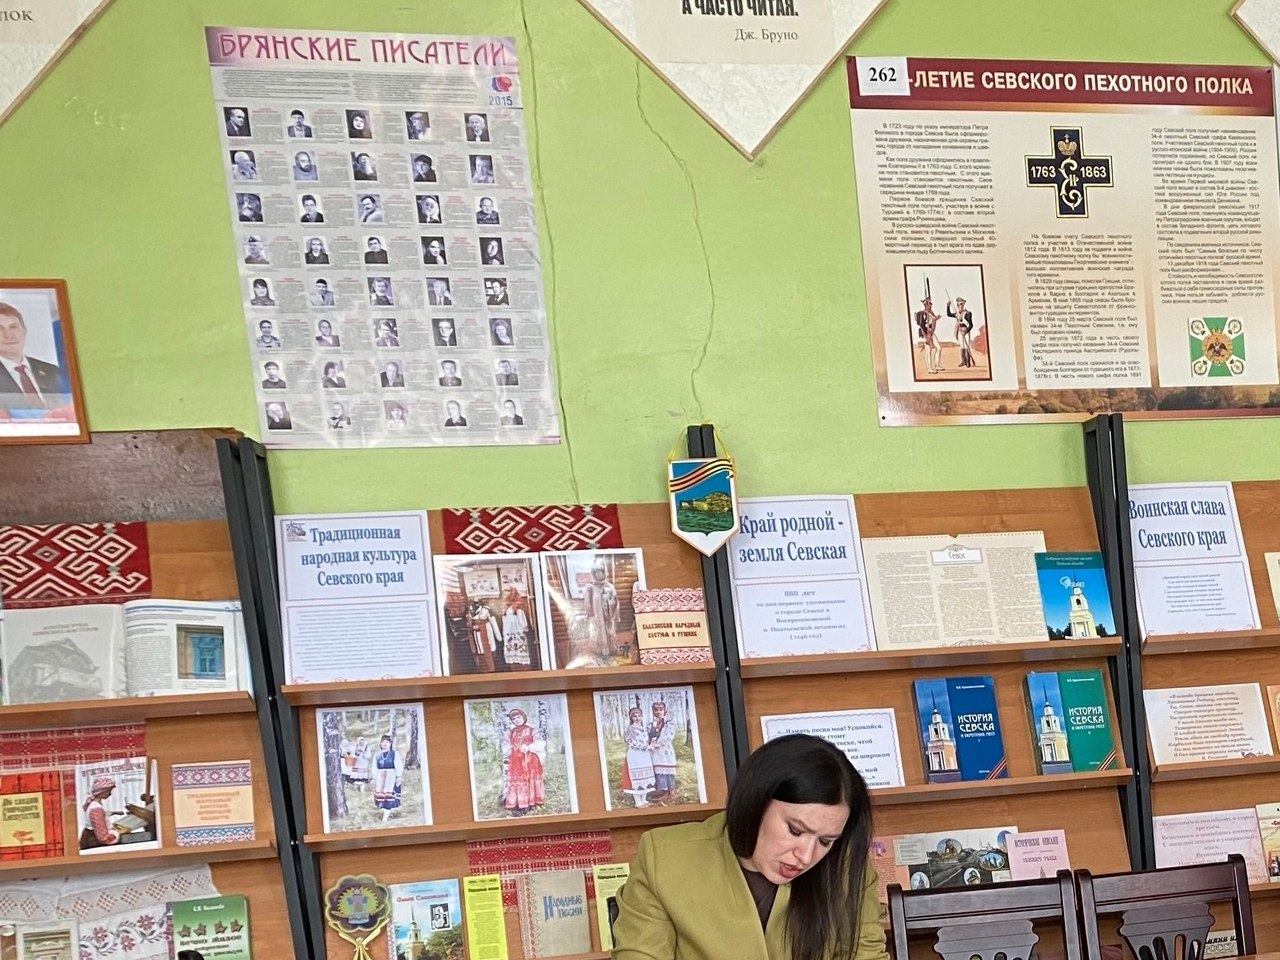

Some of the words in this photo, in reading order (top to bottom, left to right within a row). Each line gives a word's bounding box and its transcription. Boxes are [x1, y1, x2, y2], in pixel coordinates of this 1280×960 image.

[682, 0, 692, 15] А
[697, 0, 744, 16] ЧАСТО
[749, 0, 799, 17] ЧИТАЯ.
[734, 28, 757, 42] Дж.
[761, 28, 799, 43] Бруно
[219, 33, 362, 62] БРЯНСКИЕ
[370, 38, 510, 67] ПИСАТЕЛИ
[868, 66, 898, 84] 262
[981, 71, 1078, 92] СЕВСКОГО
[1084, 73, 1188, 94] ПЕХОТНОГО
[1194, 75, 1254, 96] ПОЛКА
[488, 95, 514, 107] 2015
[1030, 165, 1057, 178] 1763
[1080, 165, 1107, 178] 1863
[1128, 497, 1189, 520] Воинская
[1191, 500, 1226, 516] слава
[739, 511, 777, 538] Край
[779, 510, 834, 536] родной
[310, 525, 401, 545] Традиционная
[1138, 527, 1195, 548] Севского
[1197, 529, 1227, 550] края
[301, 550, 359, 568] народная
[362, 548, 417, 566] культура
[739, 547, 785, 563] земля
[787, 540, 847, 560] Севская
[317, 569, 373, 587] Севского
[376, 569, 404, 587] края
[957, 713, 993, 723] ИСТОРИЯ
[1069, 706, 1103, 715] ИСТОРИЯ
[959, 722, 995, 732] СЕВСКА
[1070, 715, 1104, 724] СЕВСКА
